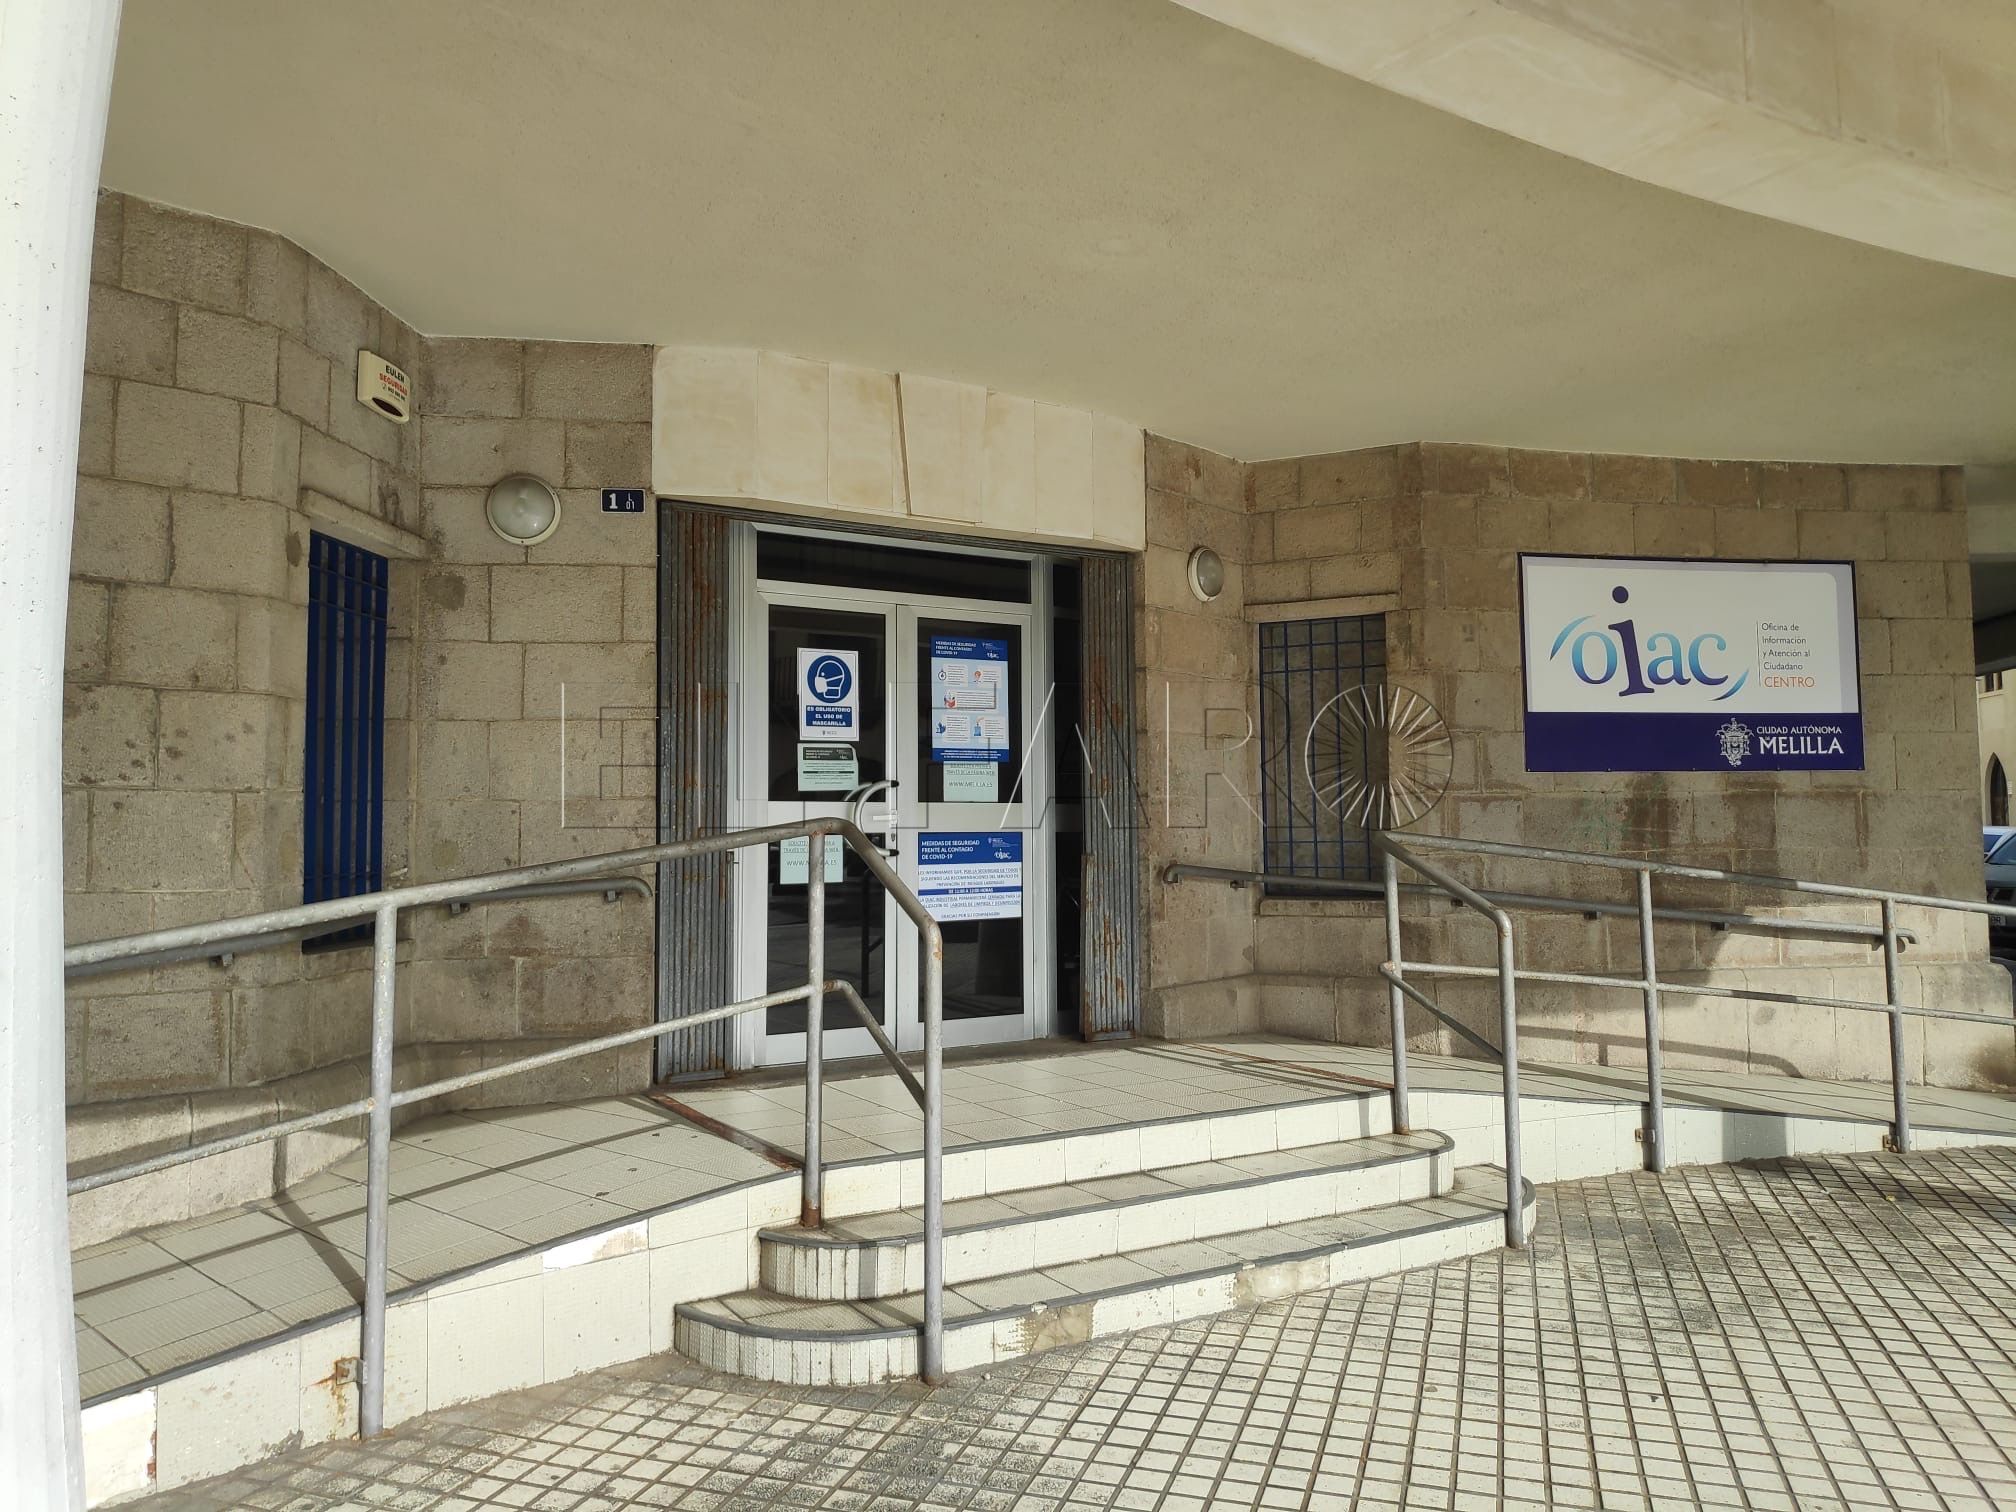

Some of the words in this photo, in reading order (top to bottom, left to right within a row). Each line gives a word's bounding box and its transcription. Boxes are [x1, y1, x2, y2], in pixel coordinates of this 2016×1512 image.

[385, 364, 405, 383] EULEN
[379, 372, 408, 396] SEGURIDAD
[609, 493, 619, 510] 1
[1761, 622, 1788, 632] Oficina
[1789, 623, 1800, 632] de
[1571, 585, 1729, 697] oiac
[1762, 635, 1807, 645] Información
[1768, 648, 1802, 658] Atención
[1804, 649, 1811, 658] al
[1763, 661, 1803, 671] Ciudadano
[1764, 676, 1815, 688] CENTRO
[1756, 726, 1788, 734] CIUDAD
[1790, 724, 1842, 734] AUTÓNOMA
[1758, 736, 1844, 755] MELILLA
